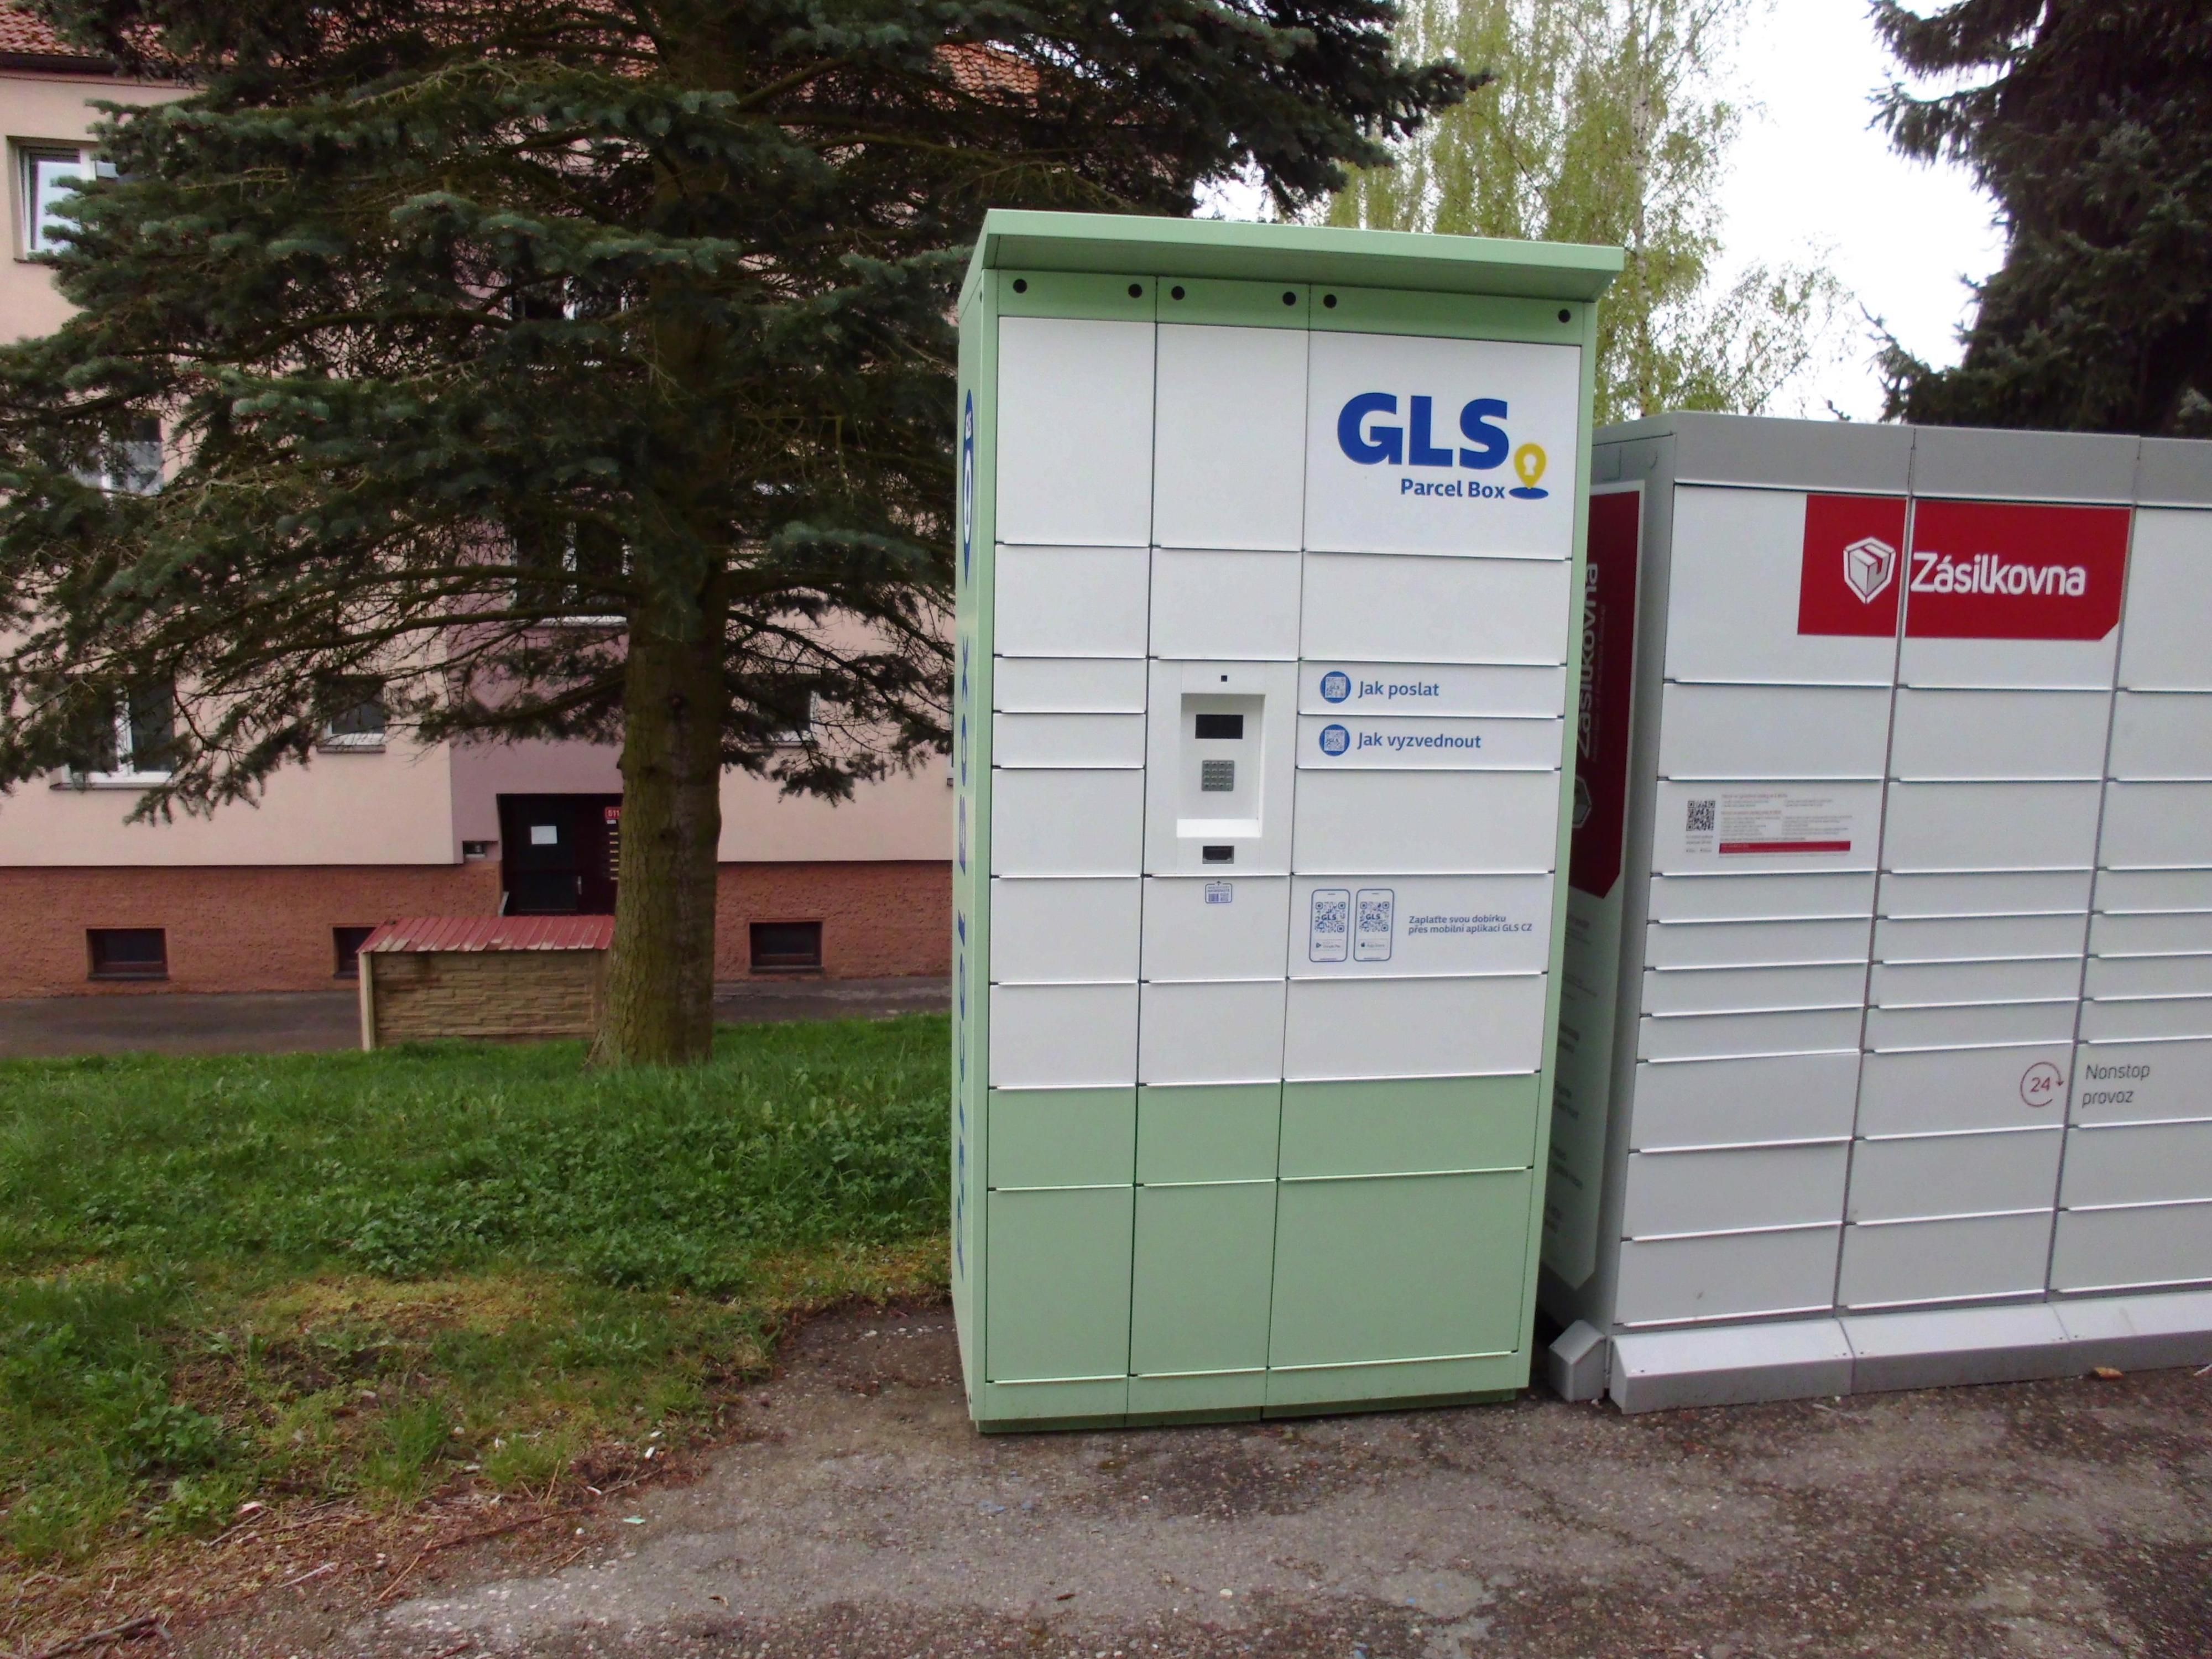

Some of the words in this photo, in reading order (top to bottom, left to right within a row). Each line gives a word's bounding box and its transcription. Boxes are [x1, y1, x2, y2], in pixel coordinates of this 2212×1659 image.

[1337, 392, 1509, 469] GLS
[1401, 478, 1463, 497] Parcel
[1468, 482, 1505, 498] Box
[1911, 552, 2086, 597] Zásilkovna
[1358, 681, 1384, 698] Jak
[1388, 682, 1439, 699] poslat
[1357, 732, 1383, 749] Jak
[1387, 734, 1481, 750] vyzvednout
[1472, 914, 1506, 924] dobírku
[1408, 925, 1428, 935] přes
[1430, 924, 1464, 933] mobilní
[1466, 924, 1500, 934] aplikaci
[1502, 924, 1519, 932] GLS
[1521, 923, 1532, 931] CZ
[2085, 1063, 2151, 1081] Nonstop
[2030, 1077, 2051, 1093] 24
[2082, 1091, 2134, 1108] provoz
